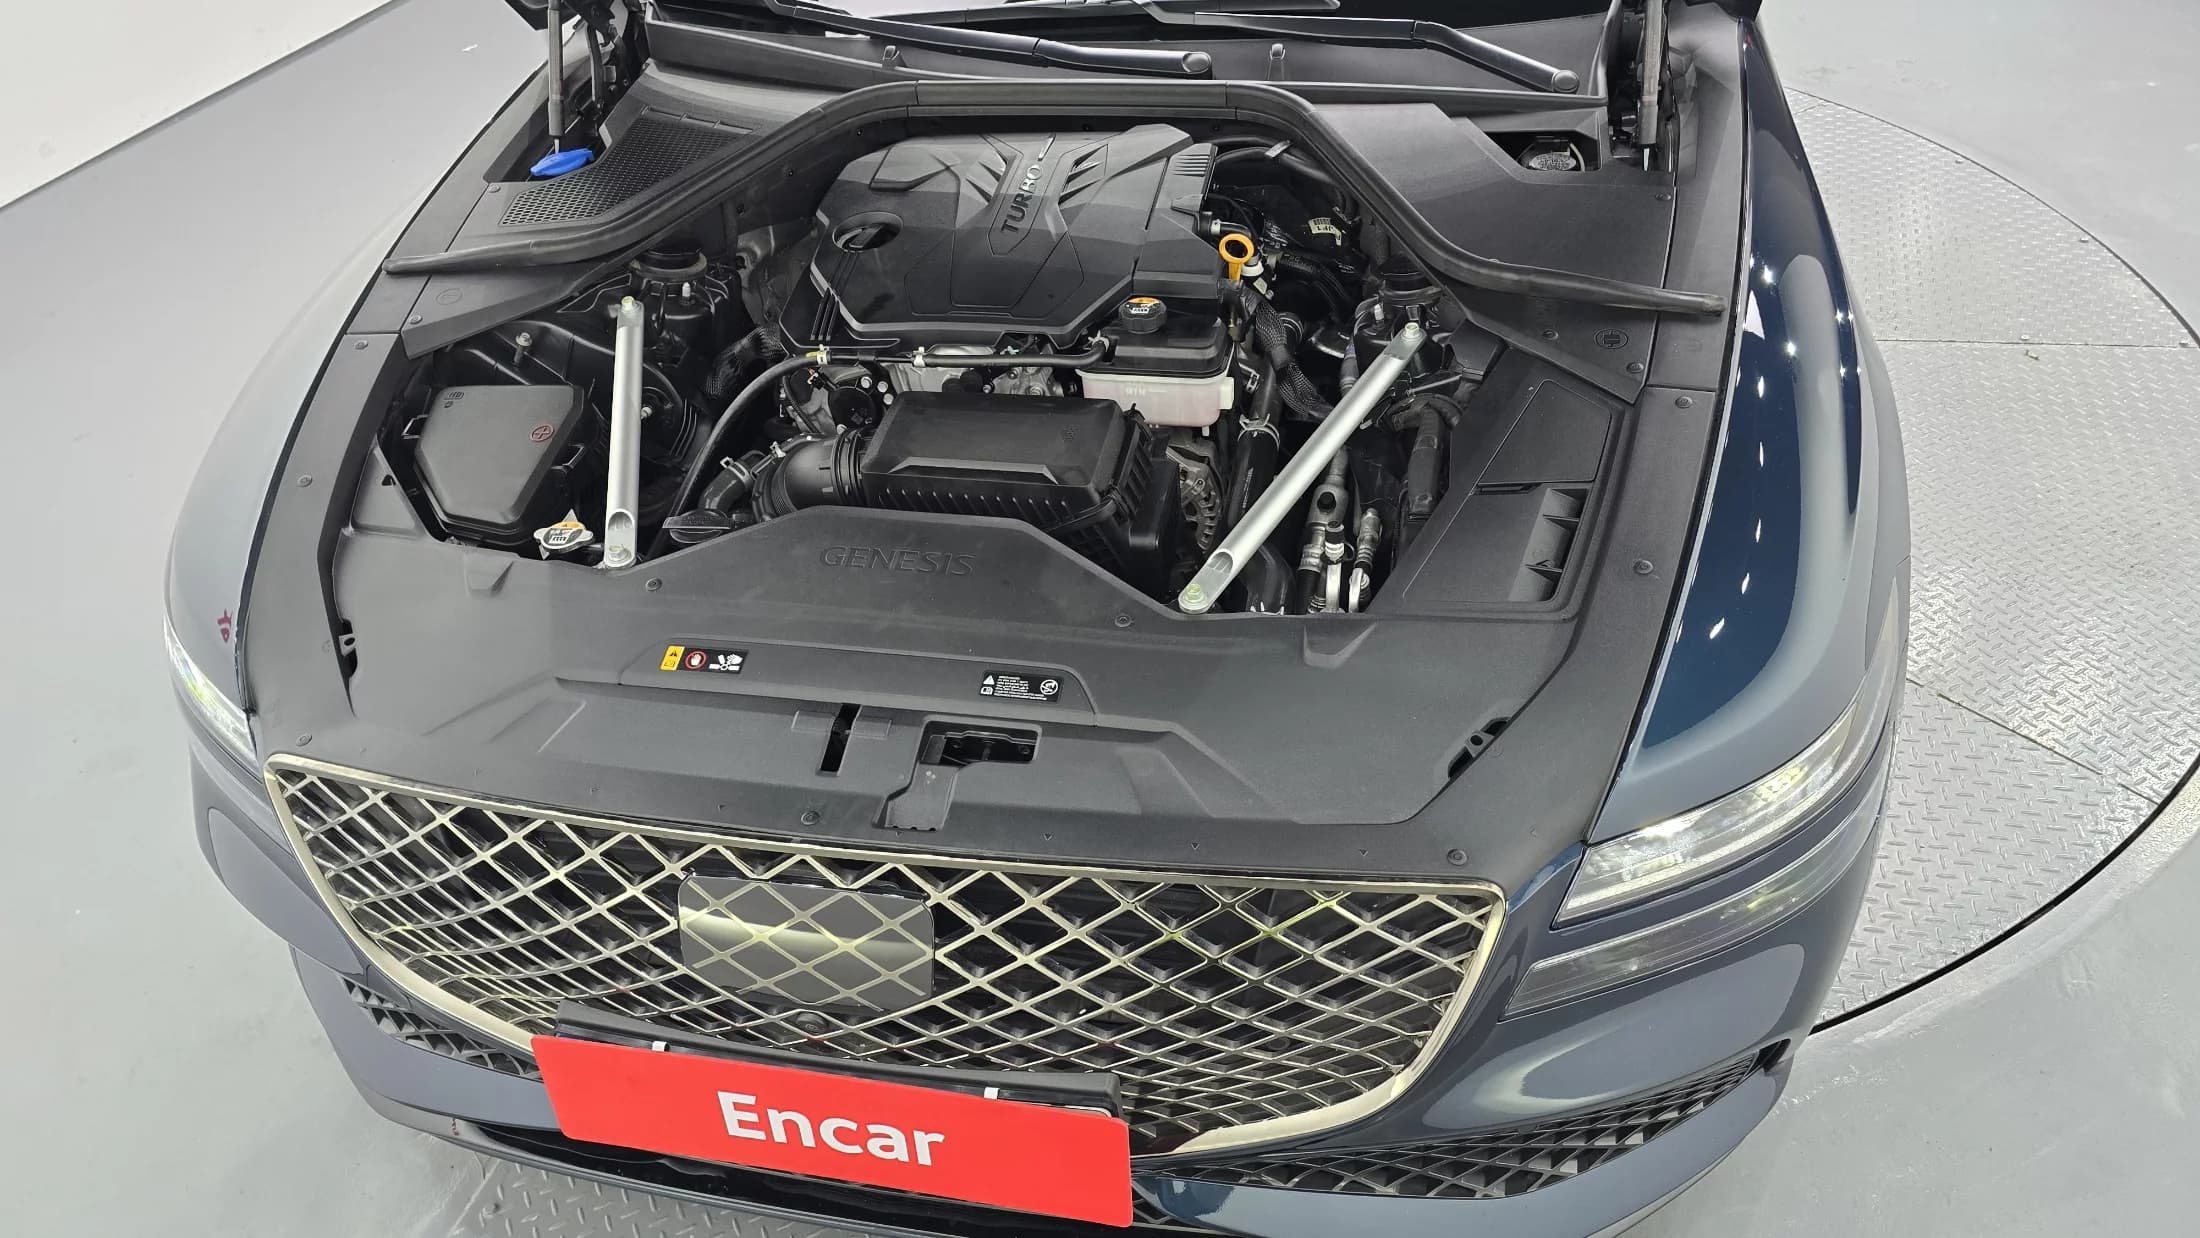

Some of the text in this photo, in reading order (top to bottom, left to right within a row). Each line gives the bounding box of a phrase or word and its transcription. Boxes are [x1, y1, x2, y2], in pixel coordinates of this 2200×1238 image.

[1001, 164, 1042, 233] TURBO
[821, 545, 976, 576] GENESIS
[717, 1090, 945, 1167] Encar
